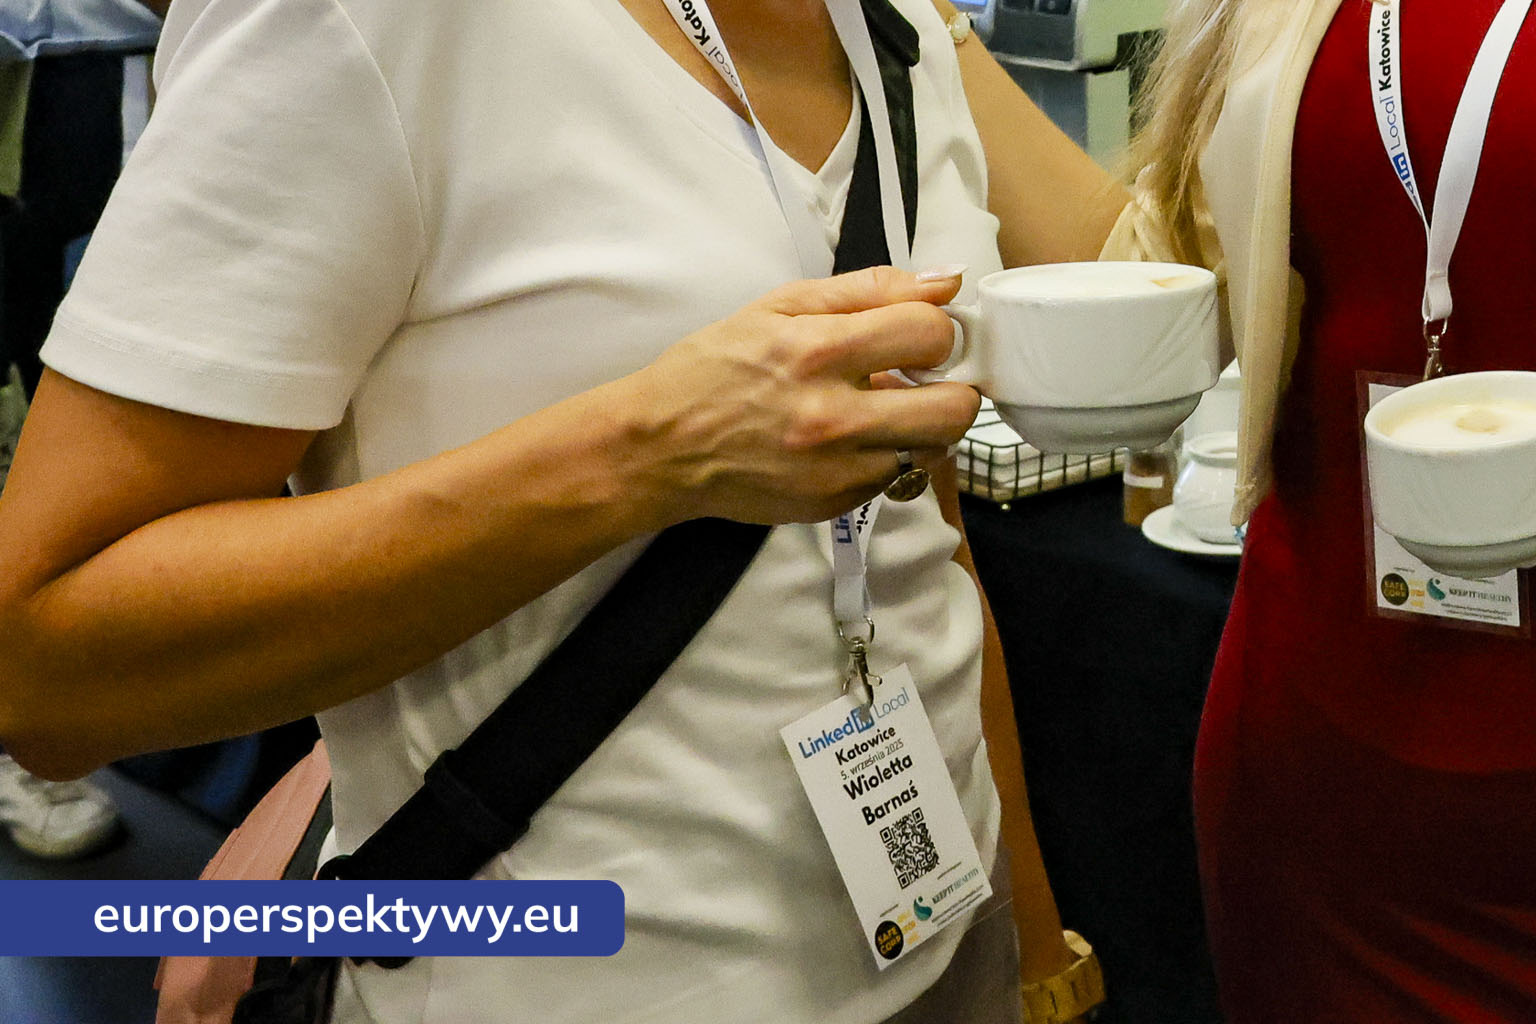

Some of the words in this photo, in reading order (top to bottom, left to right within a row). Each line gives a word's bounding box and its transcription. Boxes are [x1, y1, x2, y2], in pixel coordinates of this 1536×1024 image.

[1377, 9, 1392, 92] Katowice
[1380, 96, 1401, 151] Local
[873, 687, 910, 719] Local
[834, 725, 896, 766] Katowice
[849, 748, 886, 777] września
[886, 739, 904, 757] 2025
[843, 754, 914, 801] Wioletta
[861, 780, 919, 826] Barnaś
